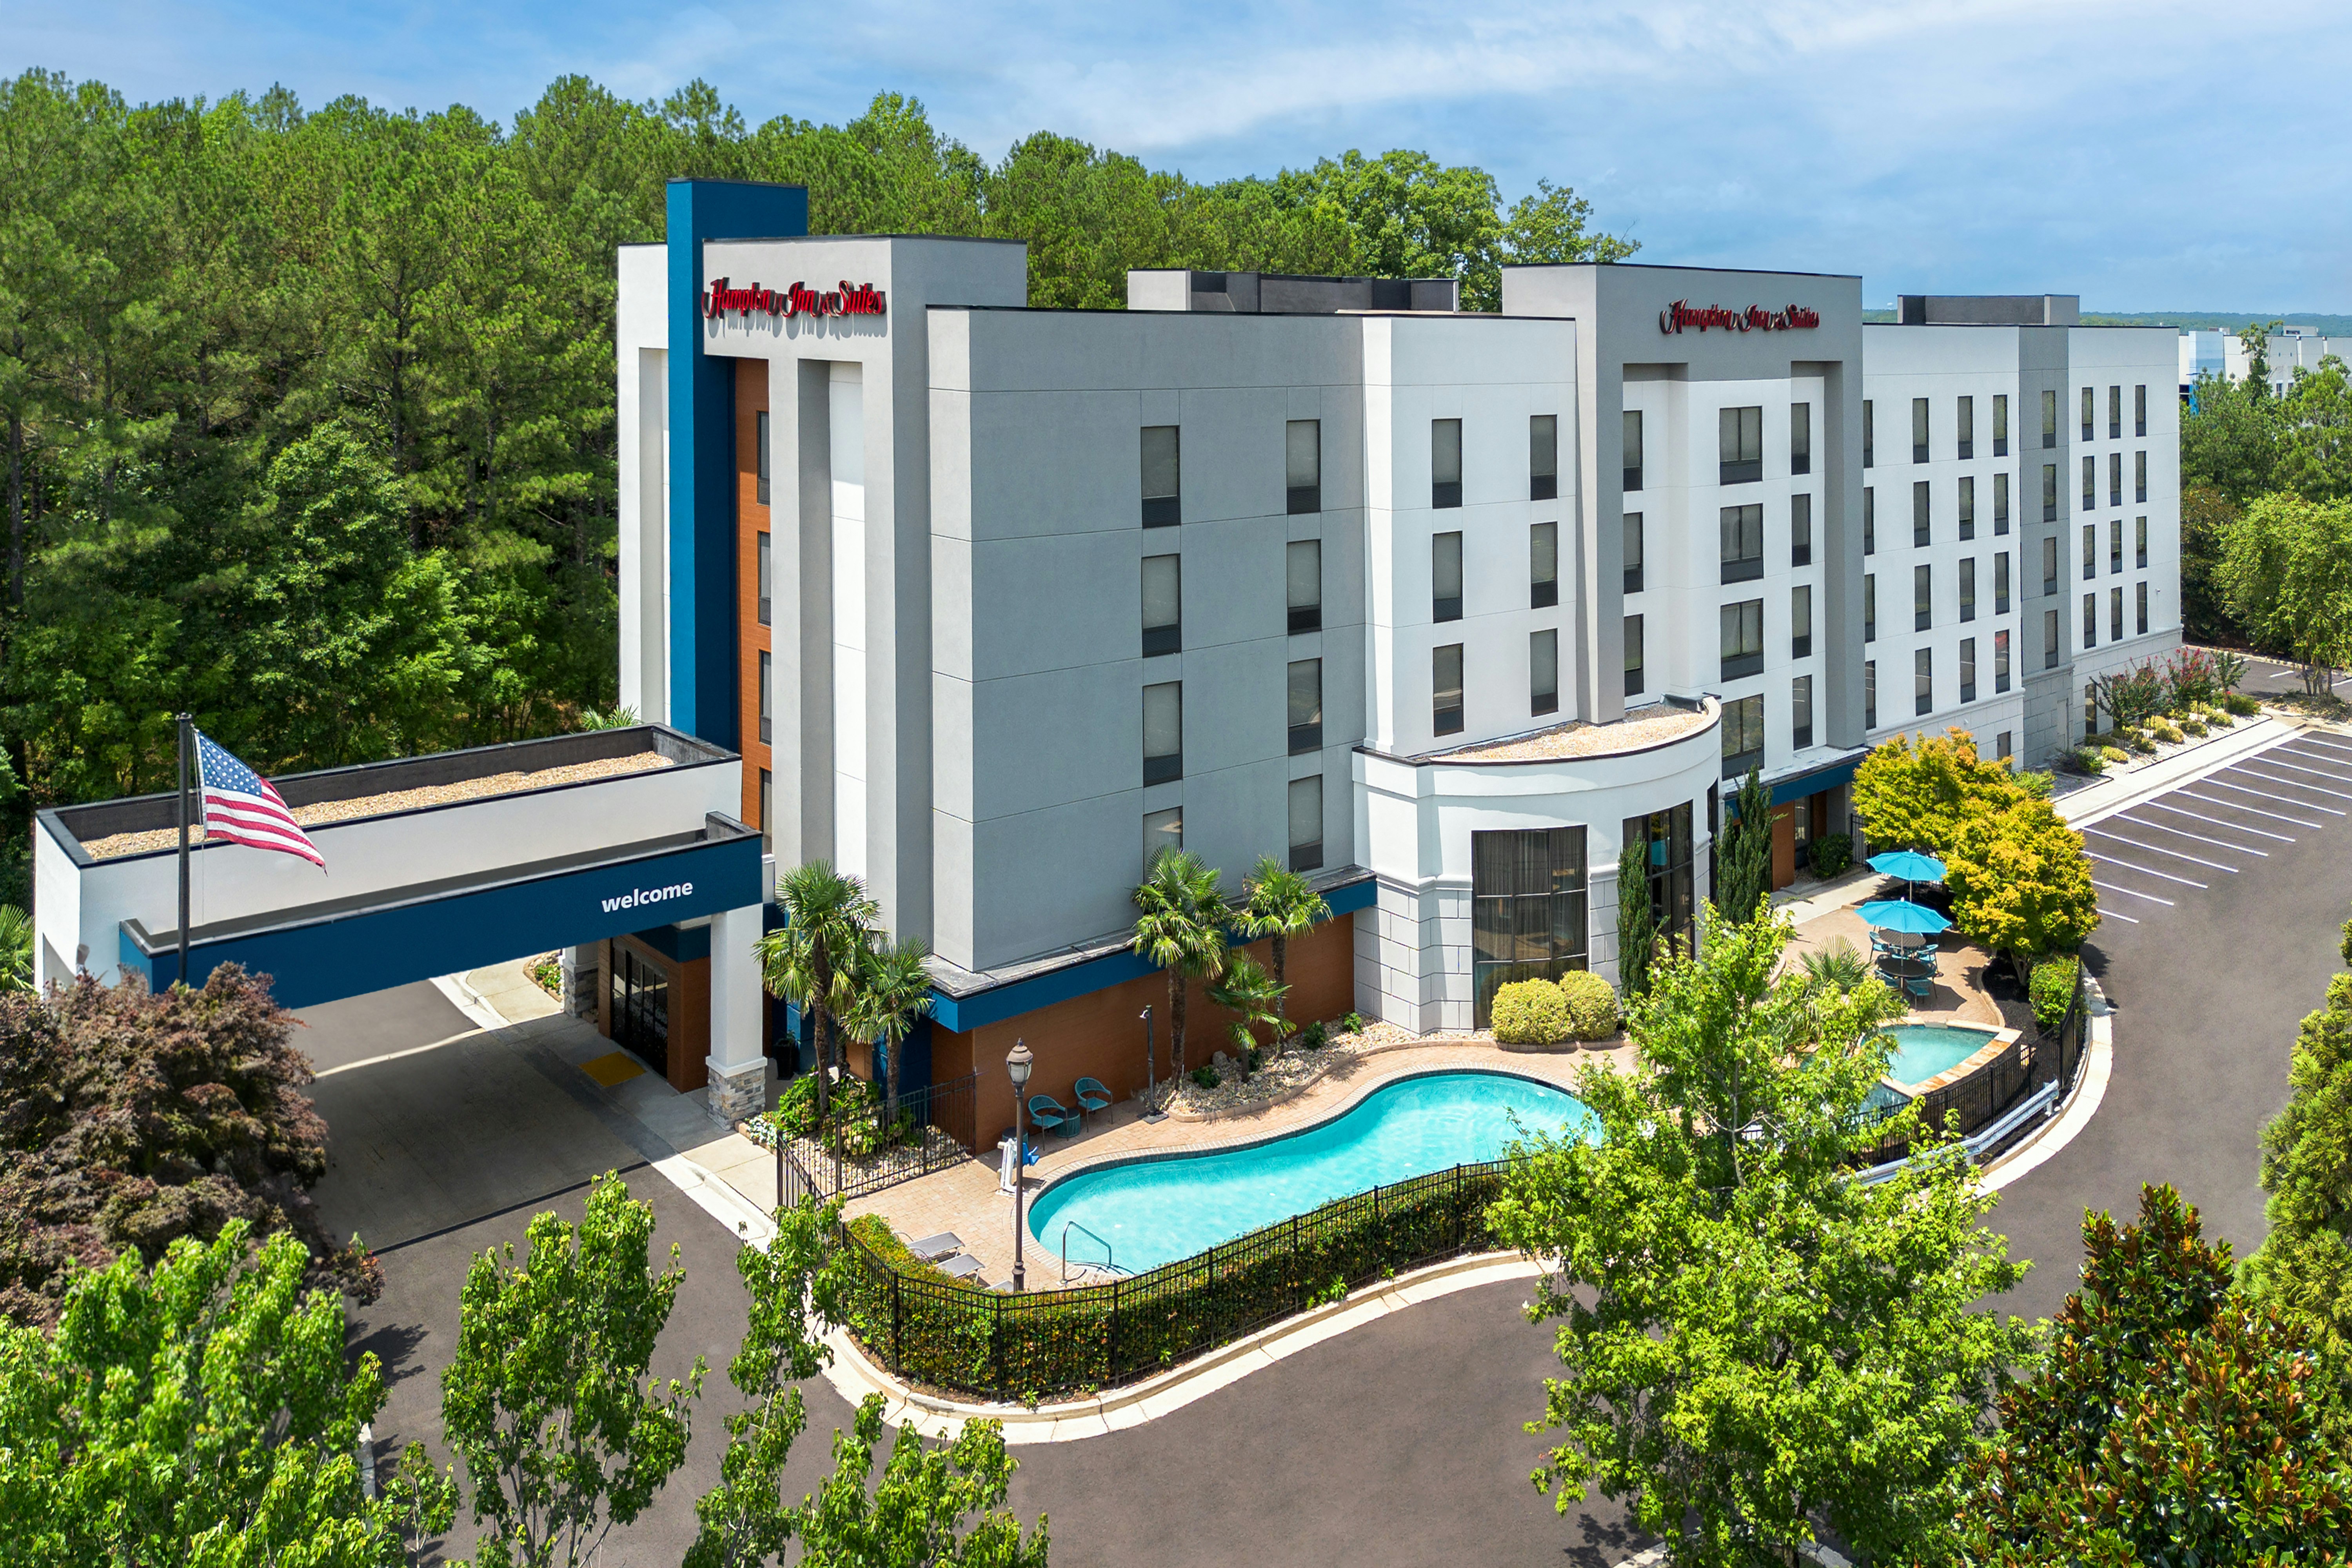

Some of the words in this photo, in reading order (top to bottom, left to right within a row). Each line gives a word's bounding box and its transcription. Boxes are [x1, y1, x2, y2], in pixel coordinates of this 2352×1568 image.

[701, 277, 777, 319] Hampton
[778, 281, 822, 318] Inn
[832, 280, 886, 316] Suites
[1659, 299, 1738, 334] Hampton
[1738, 304, 1774, 332] Inn
[1783, 304, 1819, 329] Suites
[601, 882, 693, 913] welcome
